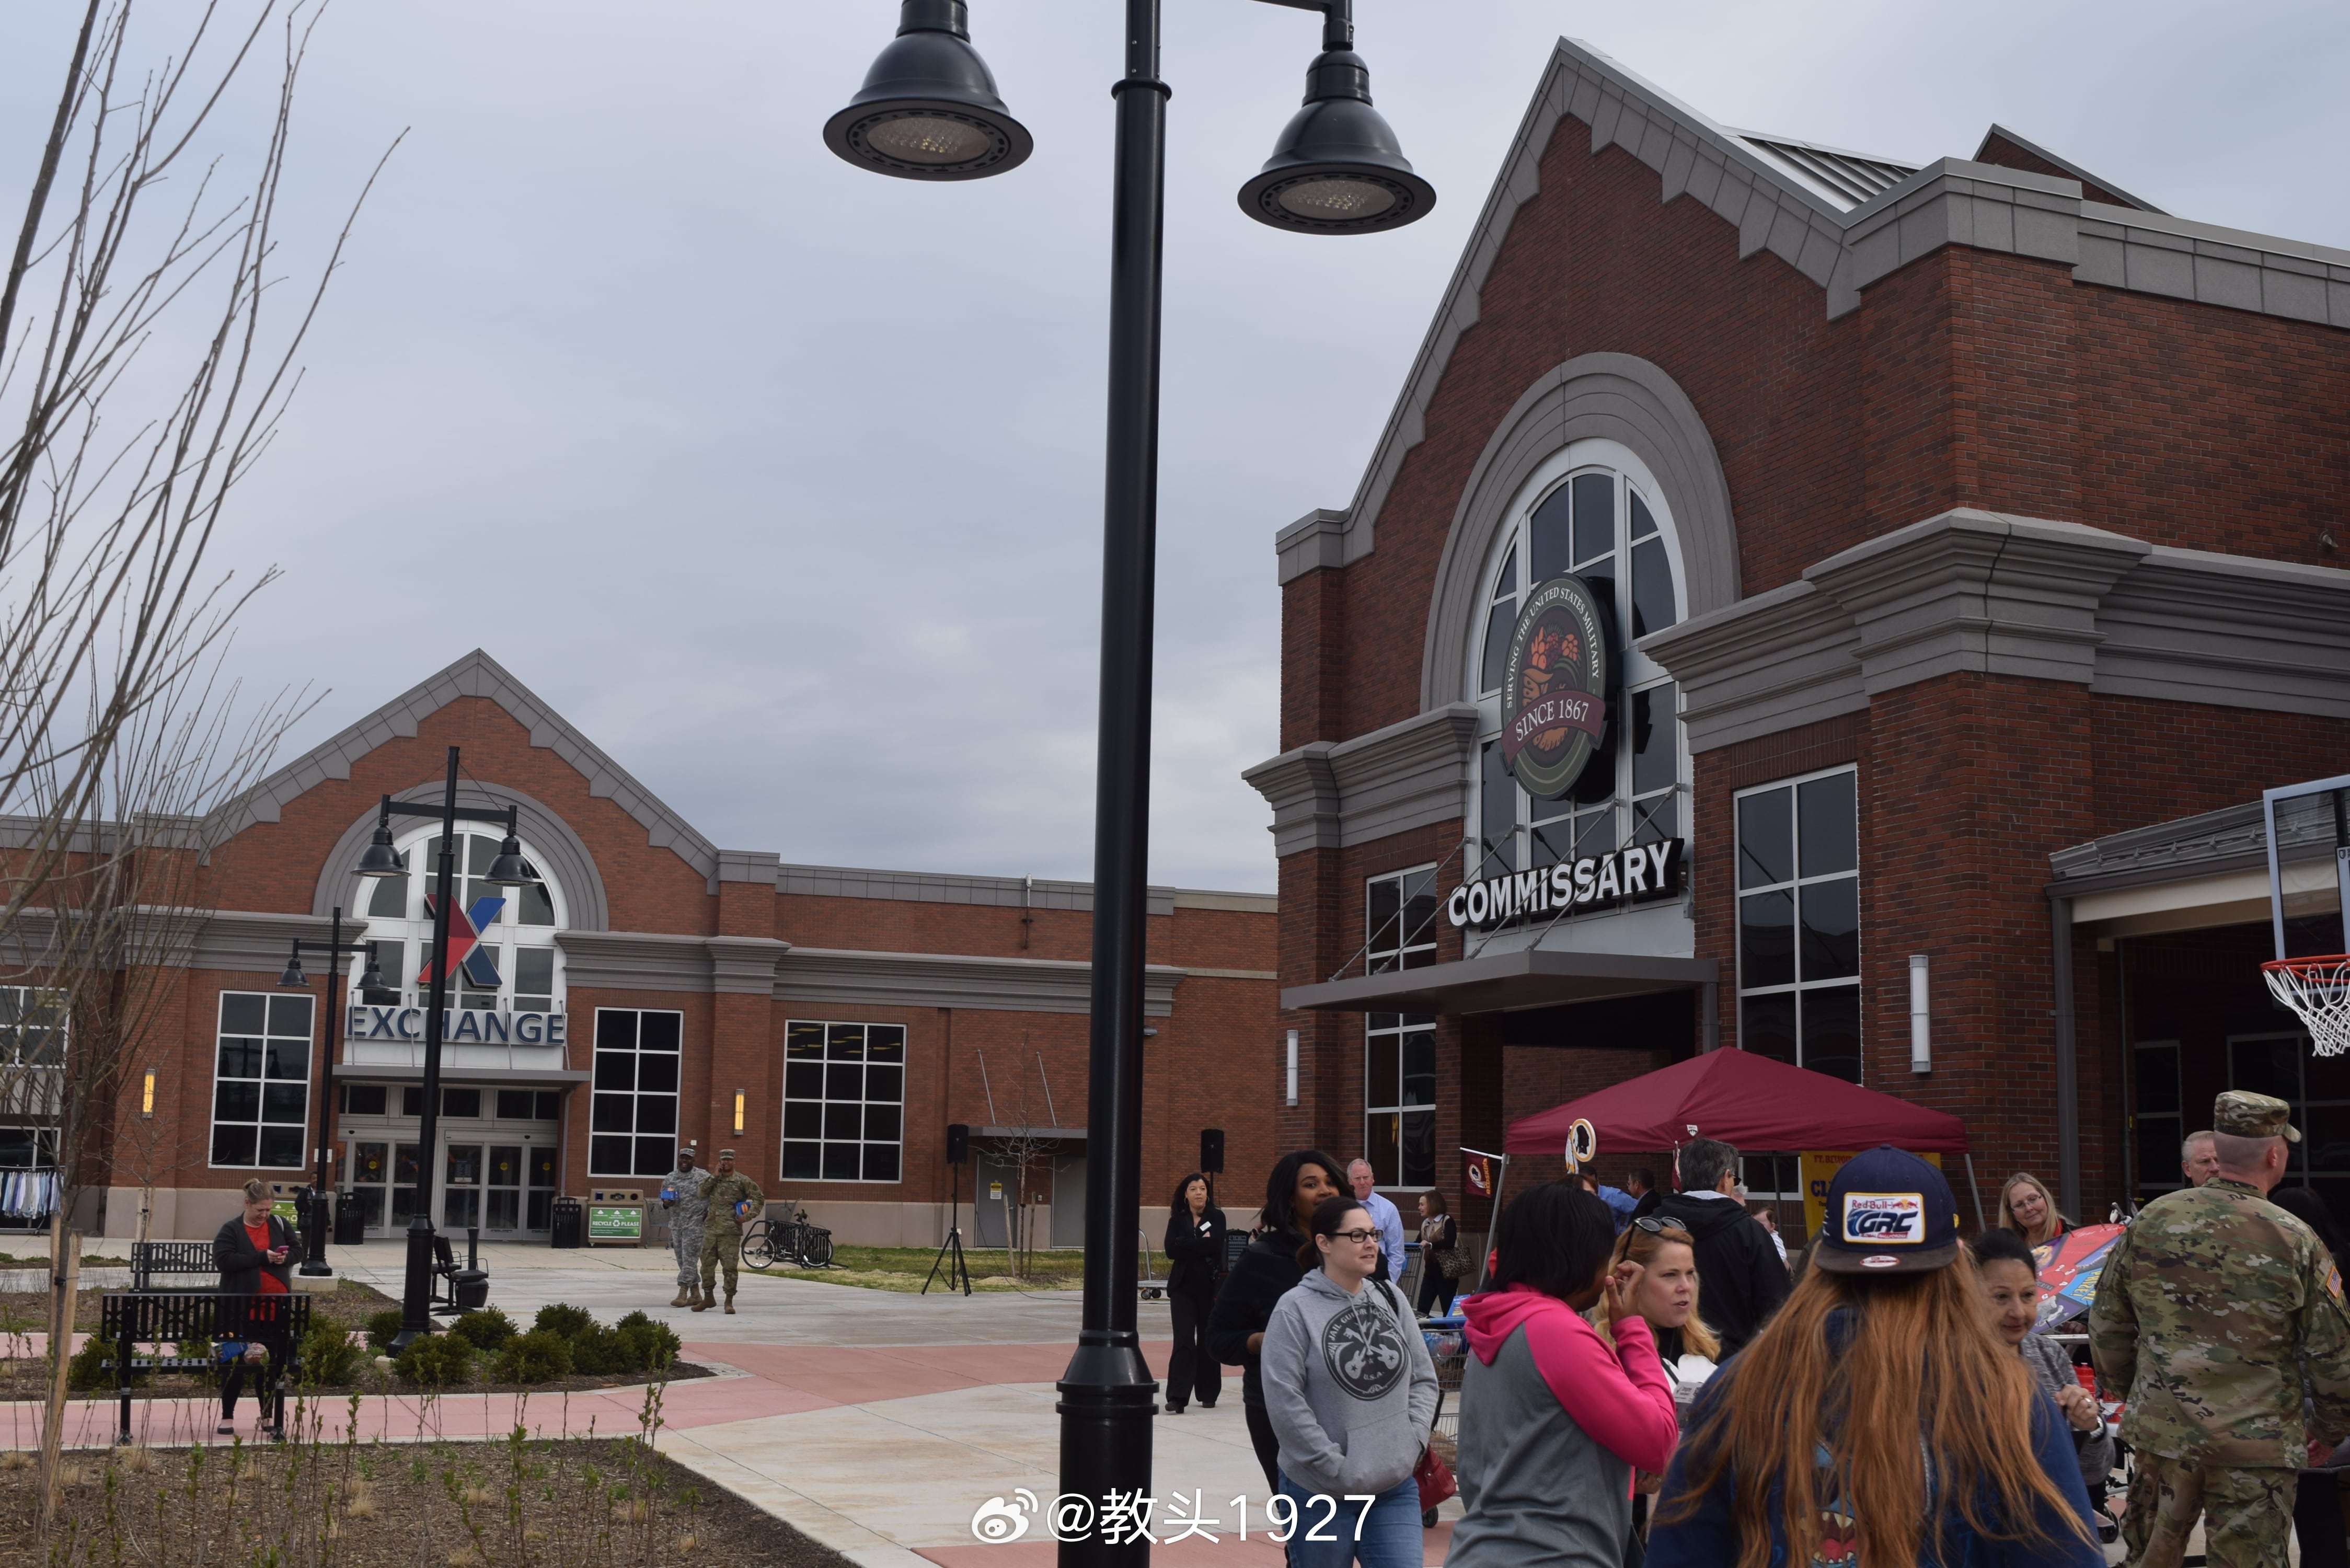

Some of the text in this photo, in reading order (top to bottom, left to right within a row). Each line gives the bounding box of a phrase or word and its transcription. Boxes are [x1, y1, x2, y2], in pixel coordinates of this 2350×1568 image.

[1507, 586, 1599, 709] SERVING THE UNITED STATES MILITARY
[1516, 698, 1589, 742] SINCE 1867
[1447, 840, 1673, 927] COMMISSARY
[1852, 1200, 1887, 1209] Red Bull
[1858, 1211, 1918, 1234] GRC
[1328, 1324, 1342, 1341] JAIL
[1340, 1308, 1367, 1323] GUIAR
